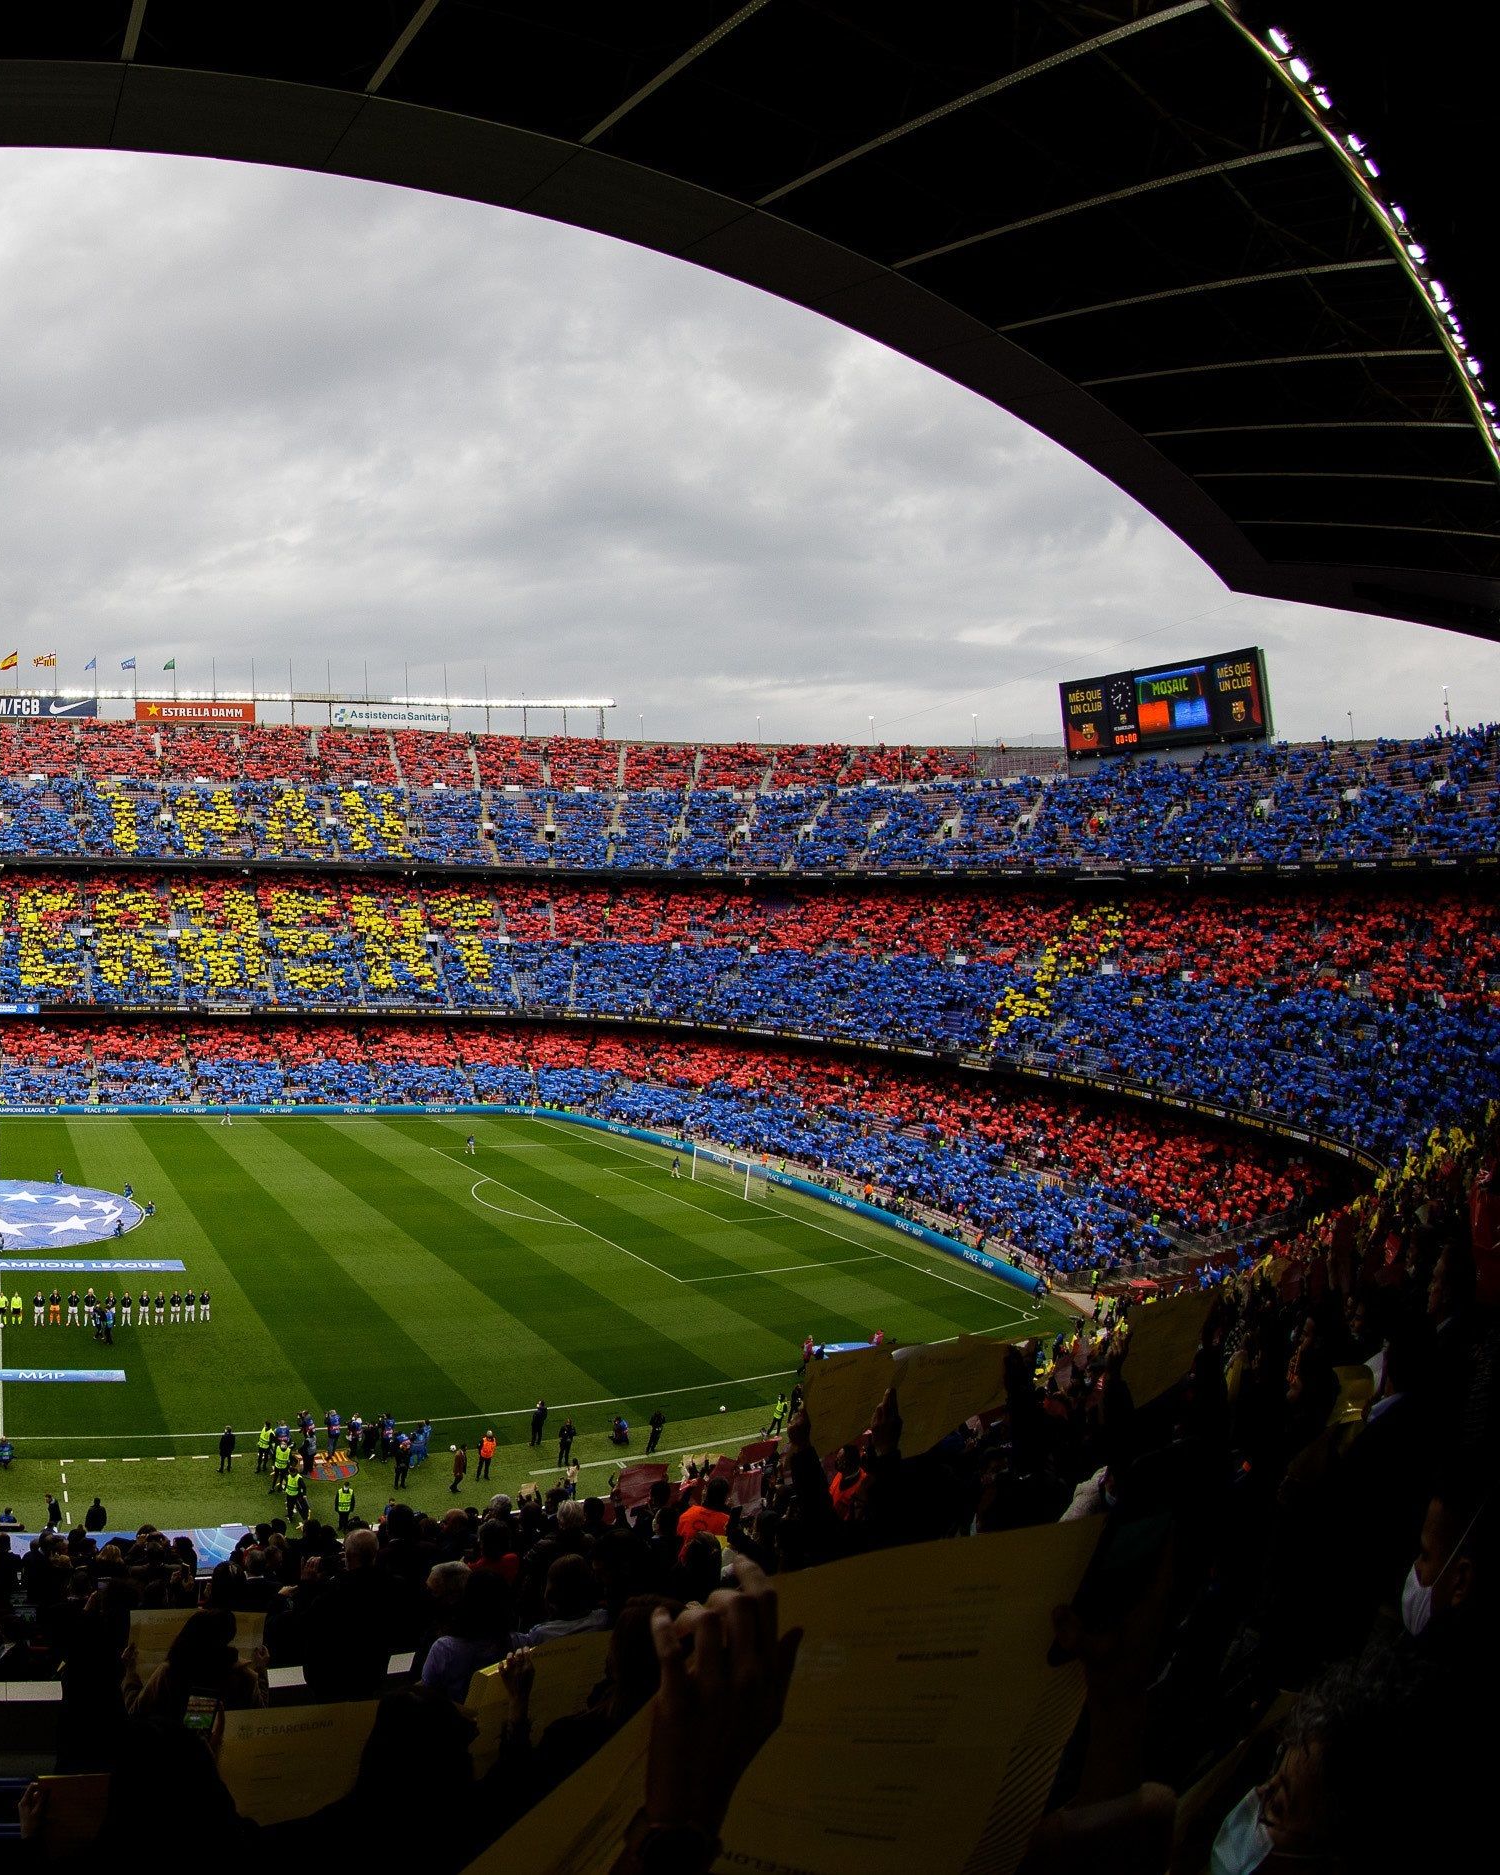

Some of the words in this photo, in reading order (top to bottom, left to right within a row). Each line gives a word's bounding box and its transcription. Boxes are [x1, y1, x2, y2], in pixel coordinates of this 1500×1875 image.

[1235, 662, 1251, 675] QUE
[1152, 677, 1189, 696] MOSAIC
[1219, 681, 1231, 692] UN
[1232, 677, 1253, 690] CLUB
[1086, 689, 1102, 700] QUE
[162, 707, 210, 717] ESTRELLA
[212, 707, 243, 718] DAMM
[1070, 704, 1083, 715] UN
[1084, 701, 1103, 713] CLUB
[91, 1260, 160, 1270] LEAGUE
[256, 1726, 270, 1736] FC
[271, 1719, 334, 1735] BARCELONA
